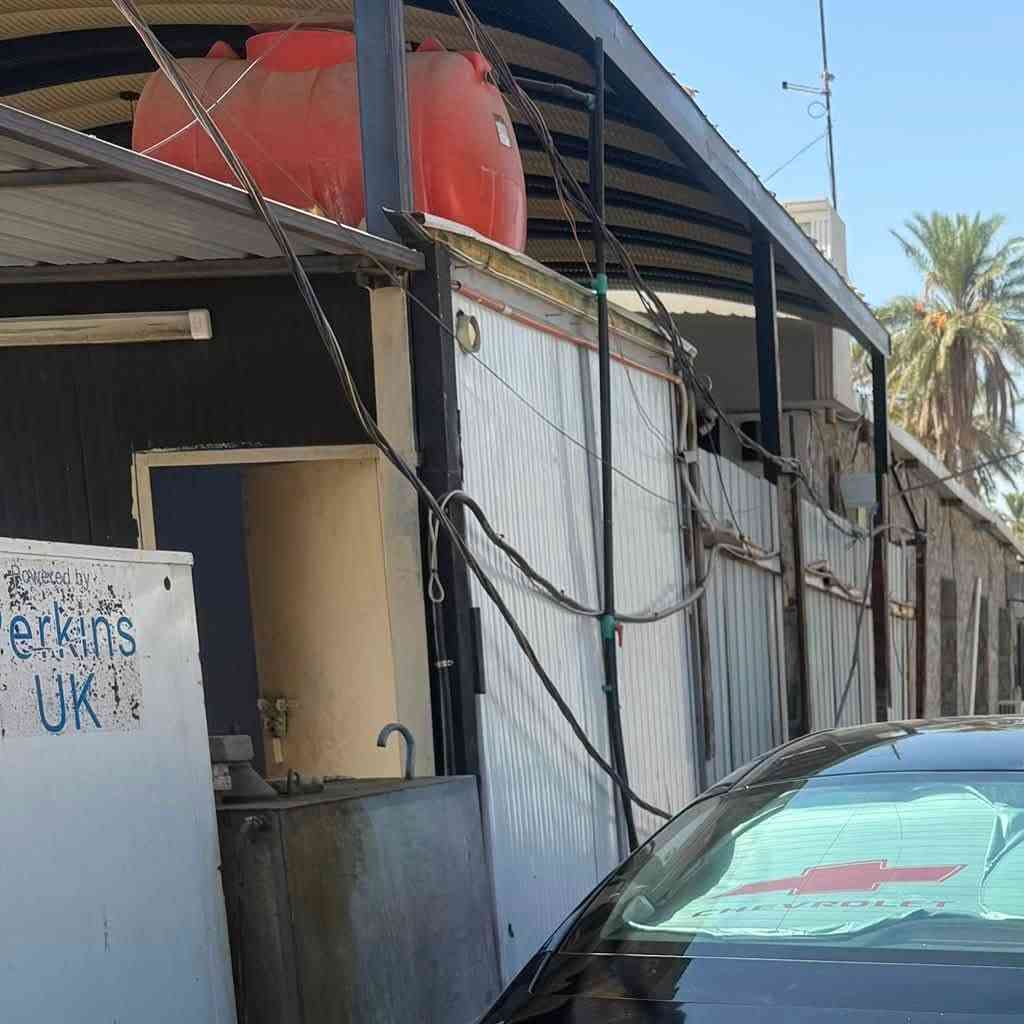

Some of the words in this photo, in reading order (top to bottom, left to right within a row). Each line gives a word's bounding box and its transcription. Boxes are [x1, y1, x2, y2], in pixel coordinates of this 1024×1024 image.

[75, 567, 91, 592] by
[0, 600, 137, 660] erkins
[34, 671, 102, 733] UK
